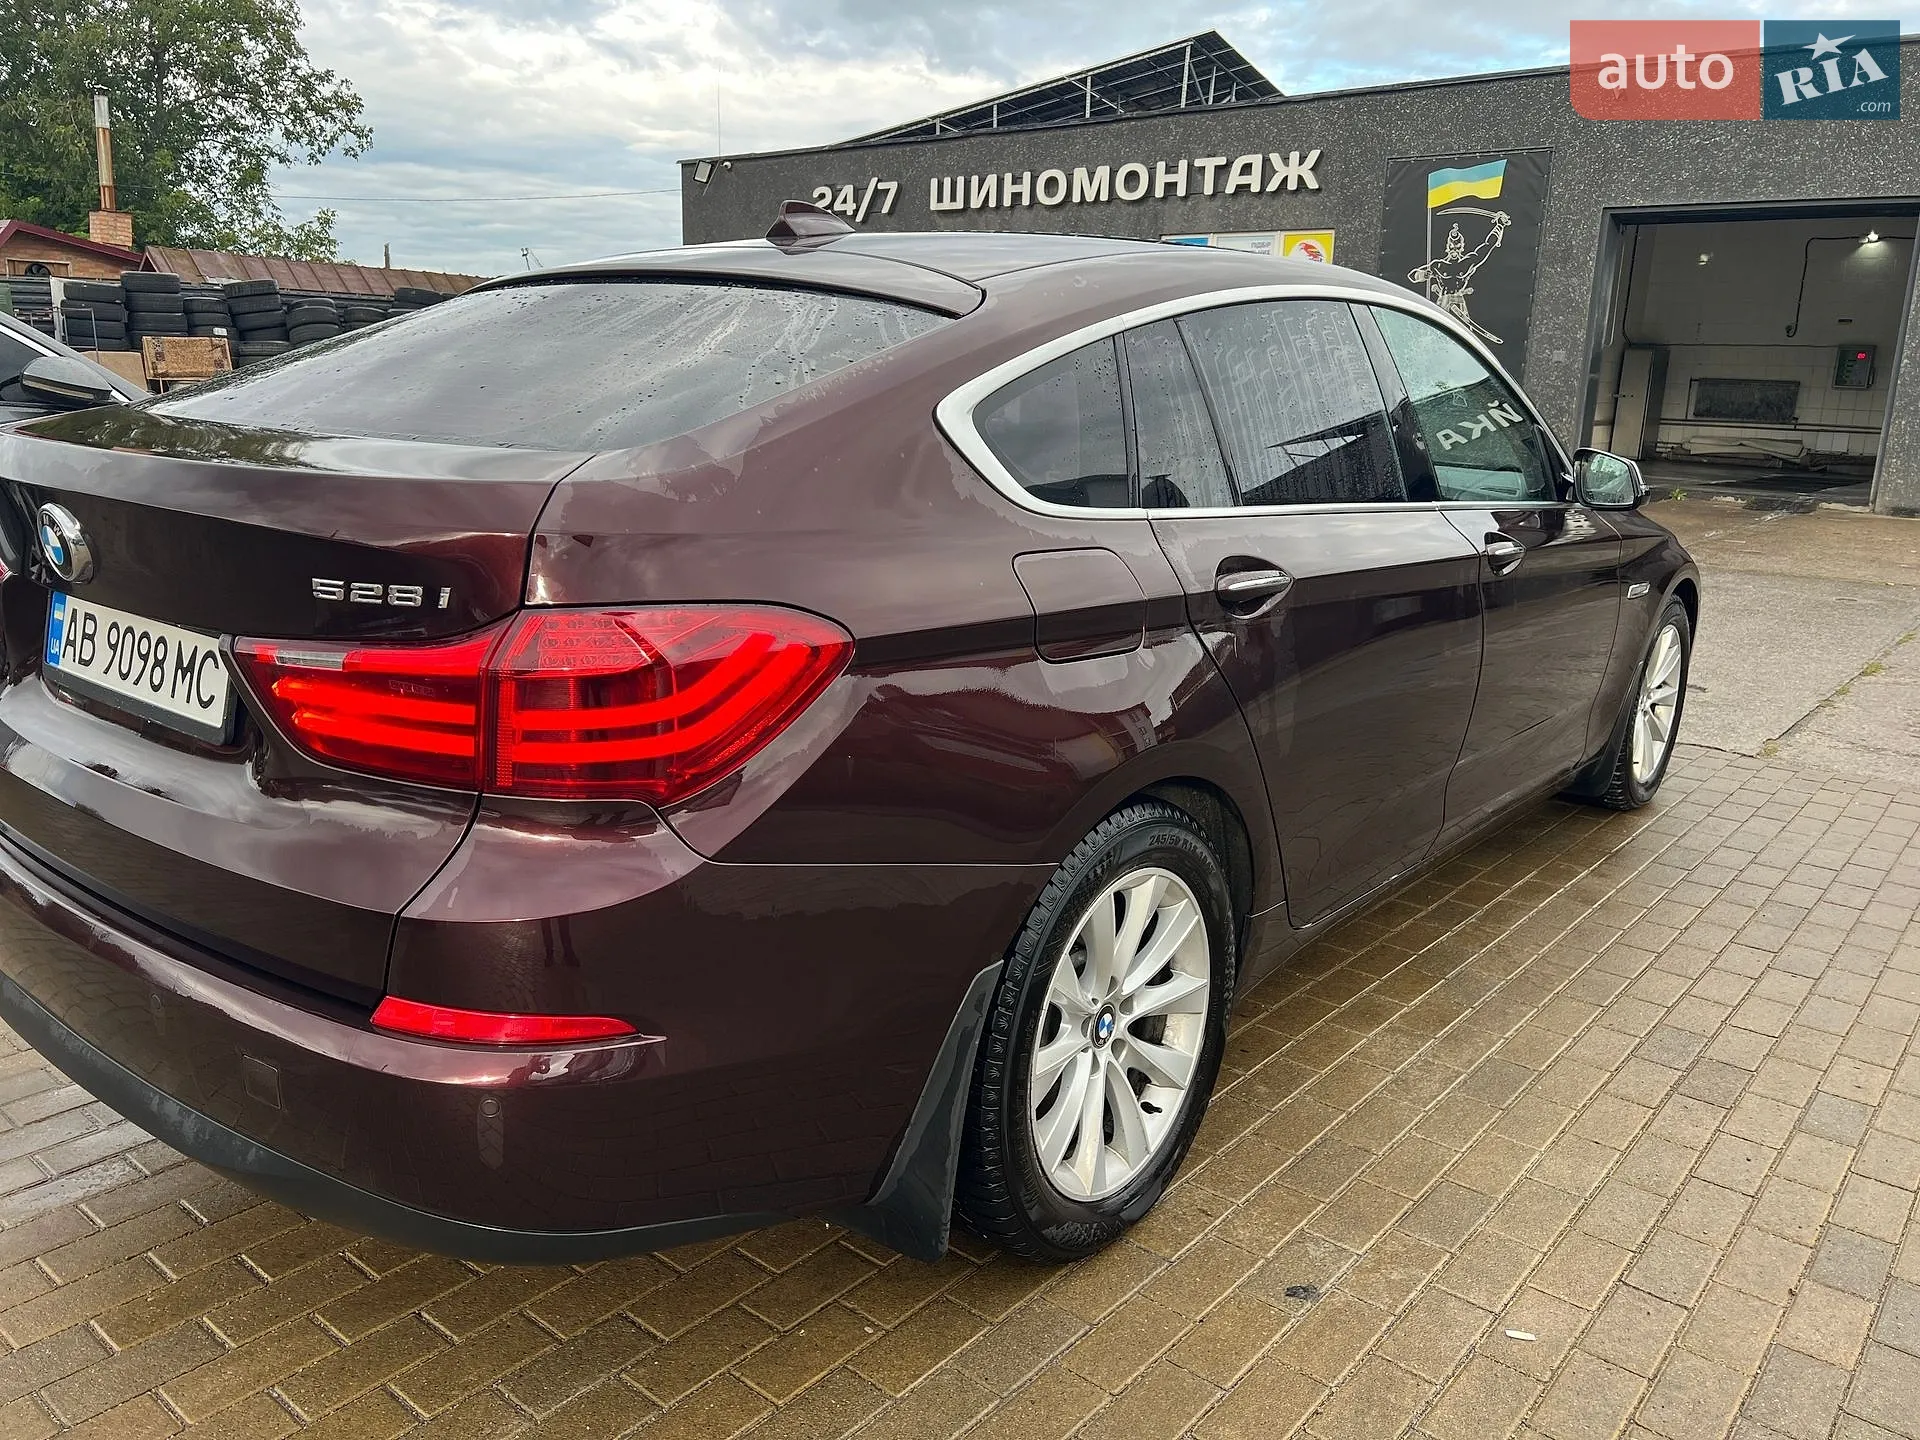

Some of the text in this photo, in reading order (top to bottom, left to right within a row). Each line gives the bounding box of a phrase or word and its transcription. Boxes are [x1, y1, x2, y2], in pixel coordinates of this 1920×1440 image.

[812, 149, 1322, 222] 24/7 ШИНОМОНТАЖ
[50, 636, 61, 655] UA
[62, 607, 219, 709] AB 9098 MC
